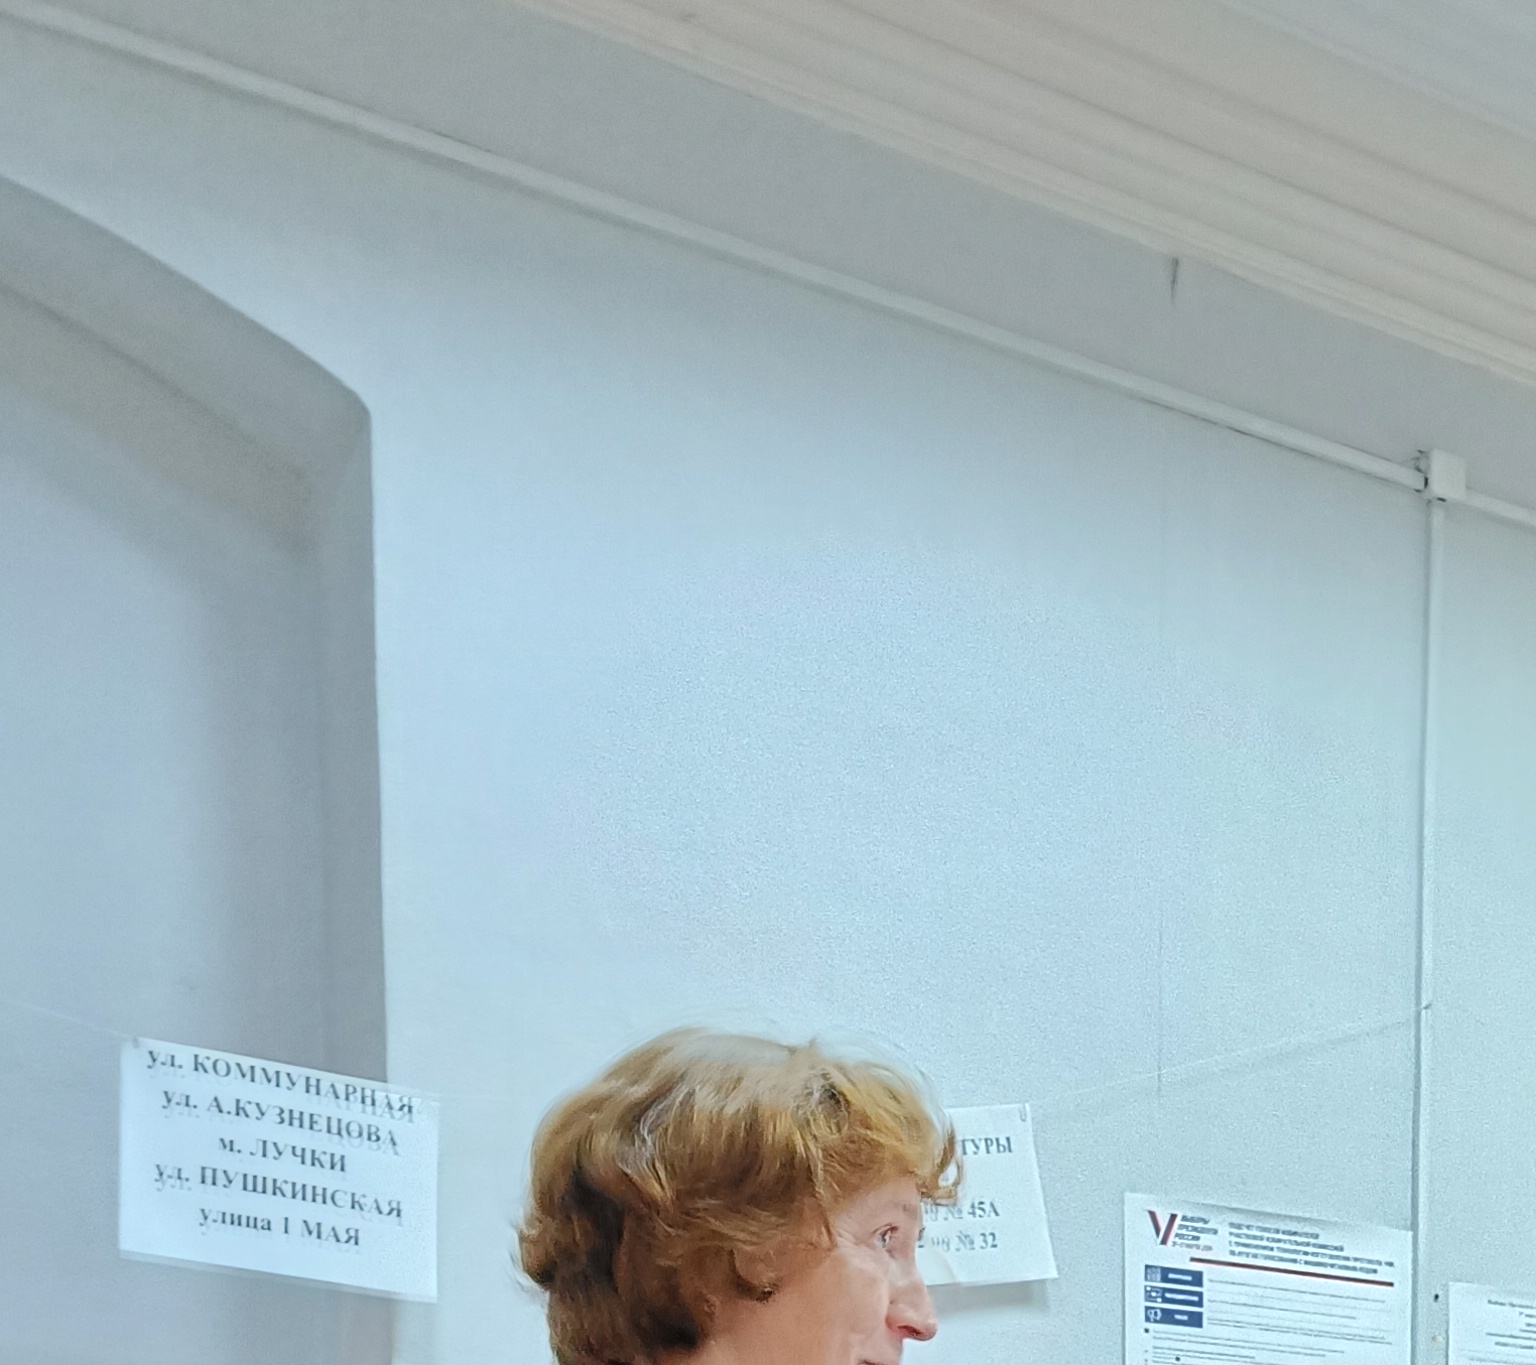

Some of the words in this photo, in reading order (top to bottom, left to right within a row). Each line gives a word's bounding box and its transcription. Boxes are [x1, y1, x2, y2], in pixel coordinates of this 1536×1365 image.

[146, 1050, 184, 1069] ул.
[192, 1053, 414, 1114] КОММУНАРНАЯ
[162, 1089, 198, 1109] ул.
[206, 1095, 398, 1147] А.КУЗНЕЦОВА
[219, 1137, 242, 1154] м.
[250, 1138, 347, 1173] ЛУЧКИ
[155, 1163, 190, 1183] ул.
[199, 1165, 403, 1218] ПУШКИНСКАЯ
[199, 1208, 272, 1232] улица
[281, 1217, 290, 1234] 1
[300, 1219, 361, 1246] МАЯ
[979, 1232, 999, 1250] 32
